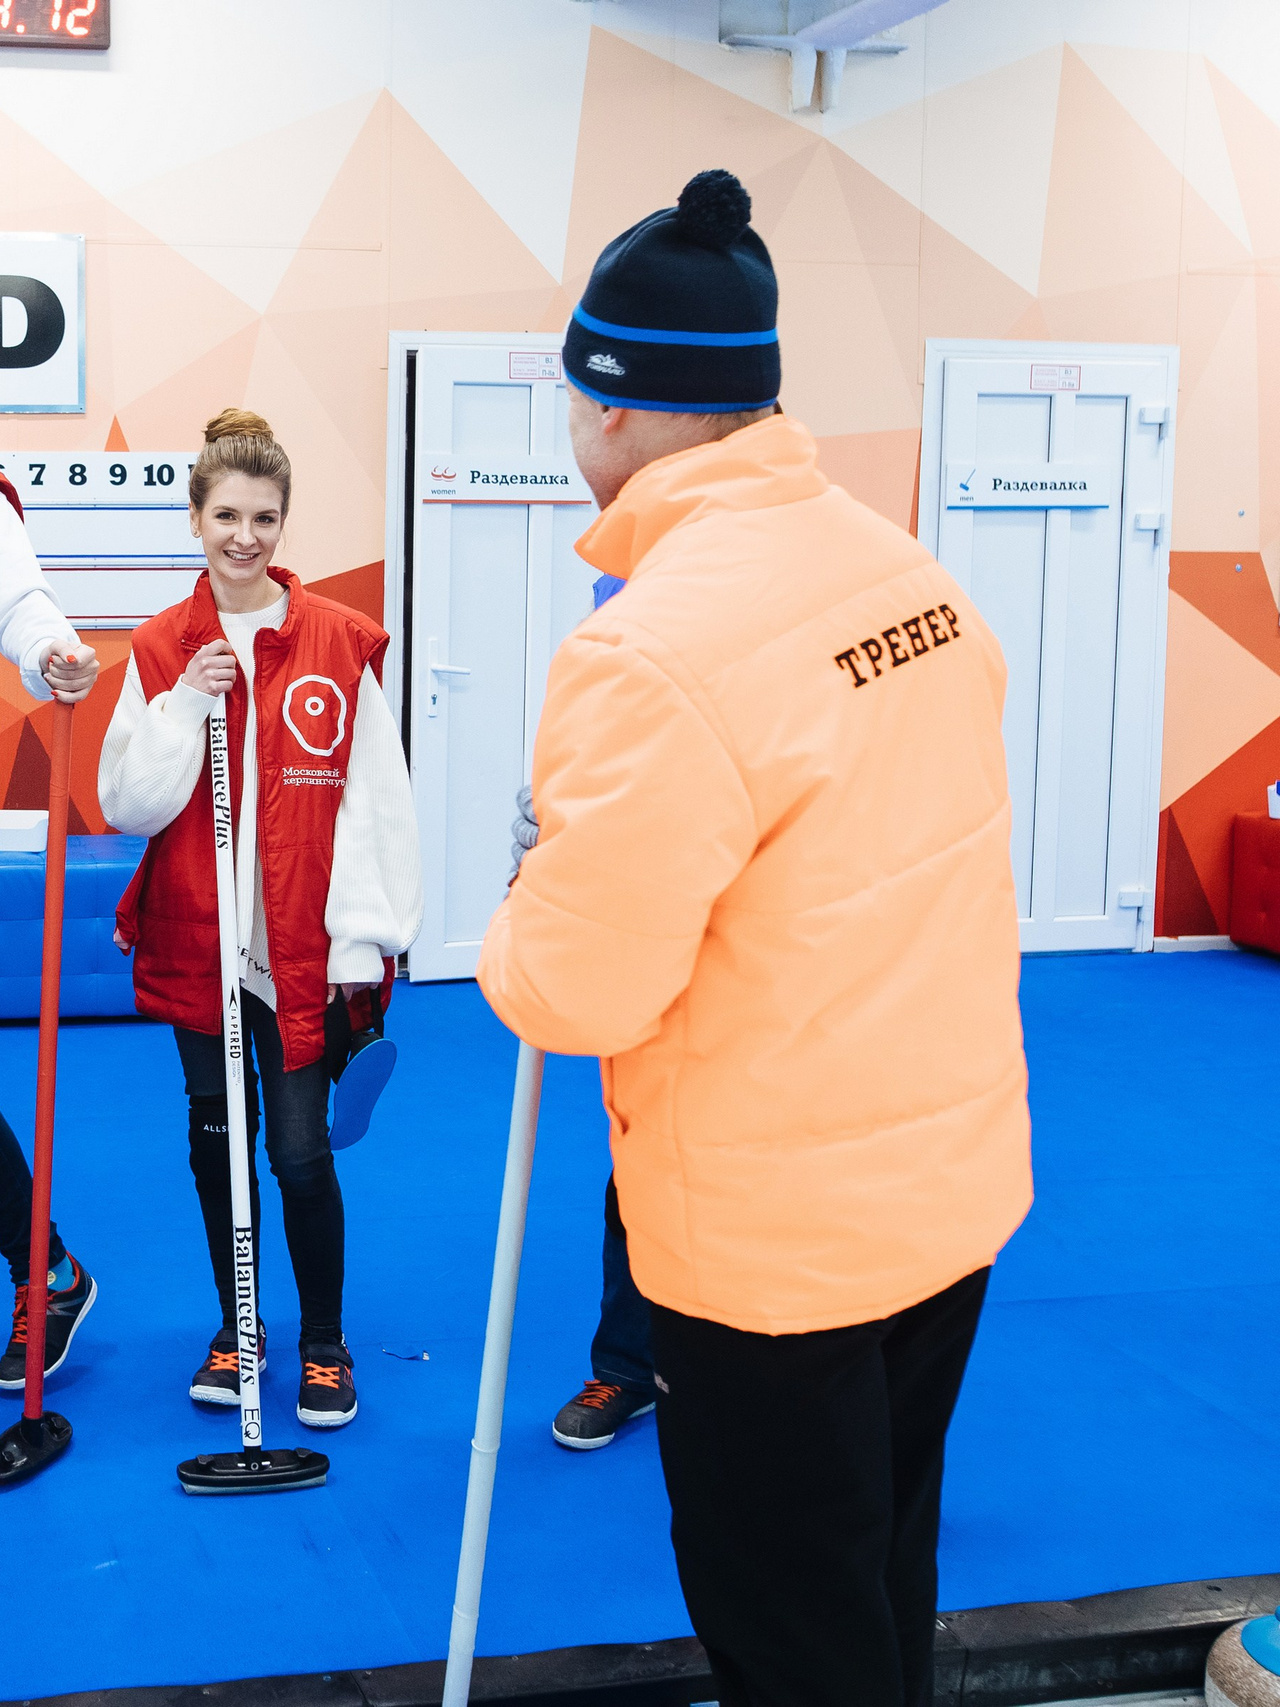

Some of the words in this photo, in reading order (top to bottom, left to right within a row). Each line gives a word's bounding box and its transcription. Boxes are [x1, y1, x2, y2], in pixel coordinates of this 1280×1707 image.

[28, 463, 46, 486] 7
[68, 463, 88, 486] 8
[109, 463, 128, 486] 9
[143, 463, 175, 486] 10
[470, 470, 570, 486] Раздевалка
[992, 478, 1088, 492] Раздевалка
[834, 603, 961, 689] ТРЕНЕР
[210, 717, 232, 850] BalancePlus
[229, 1008, 242, 1059] TAPERED
[203, 1123, 228, 1133] ALLS
[234, 1225, 258, 1386] BalancePlus
[243, 1408, 261, 1440] EQ
